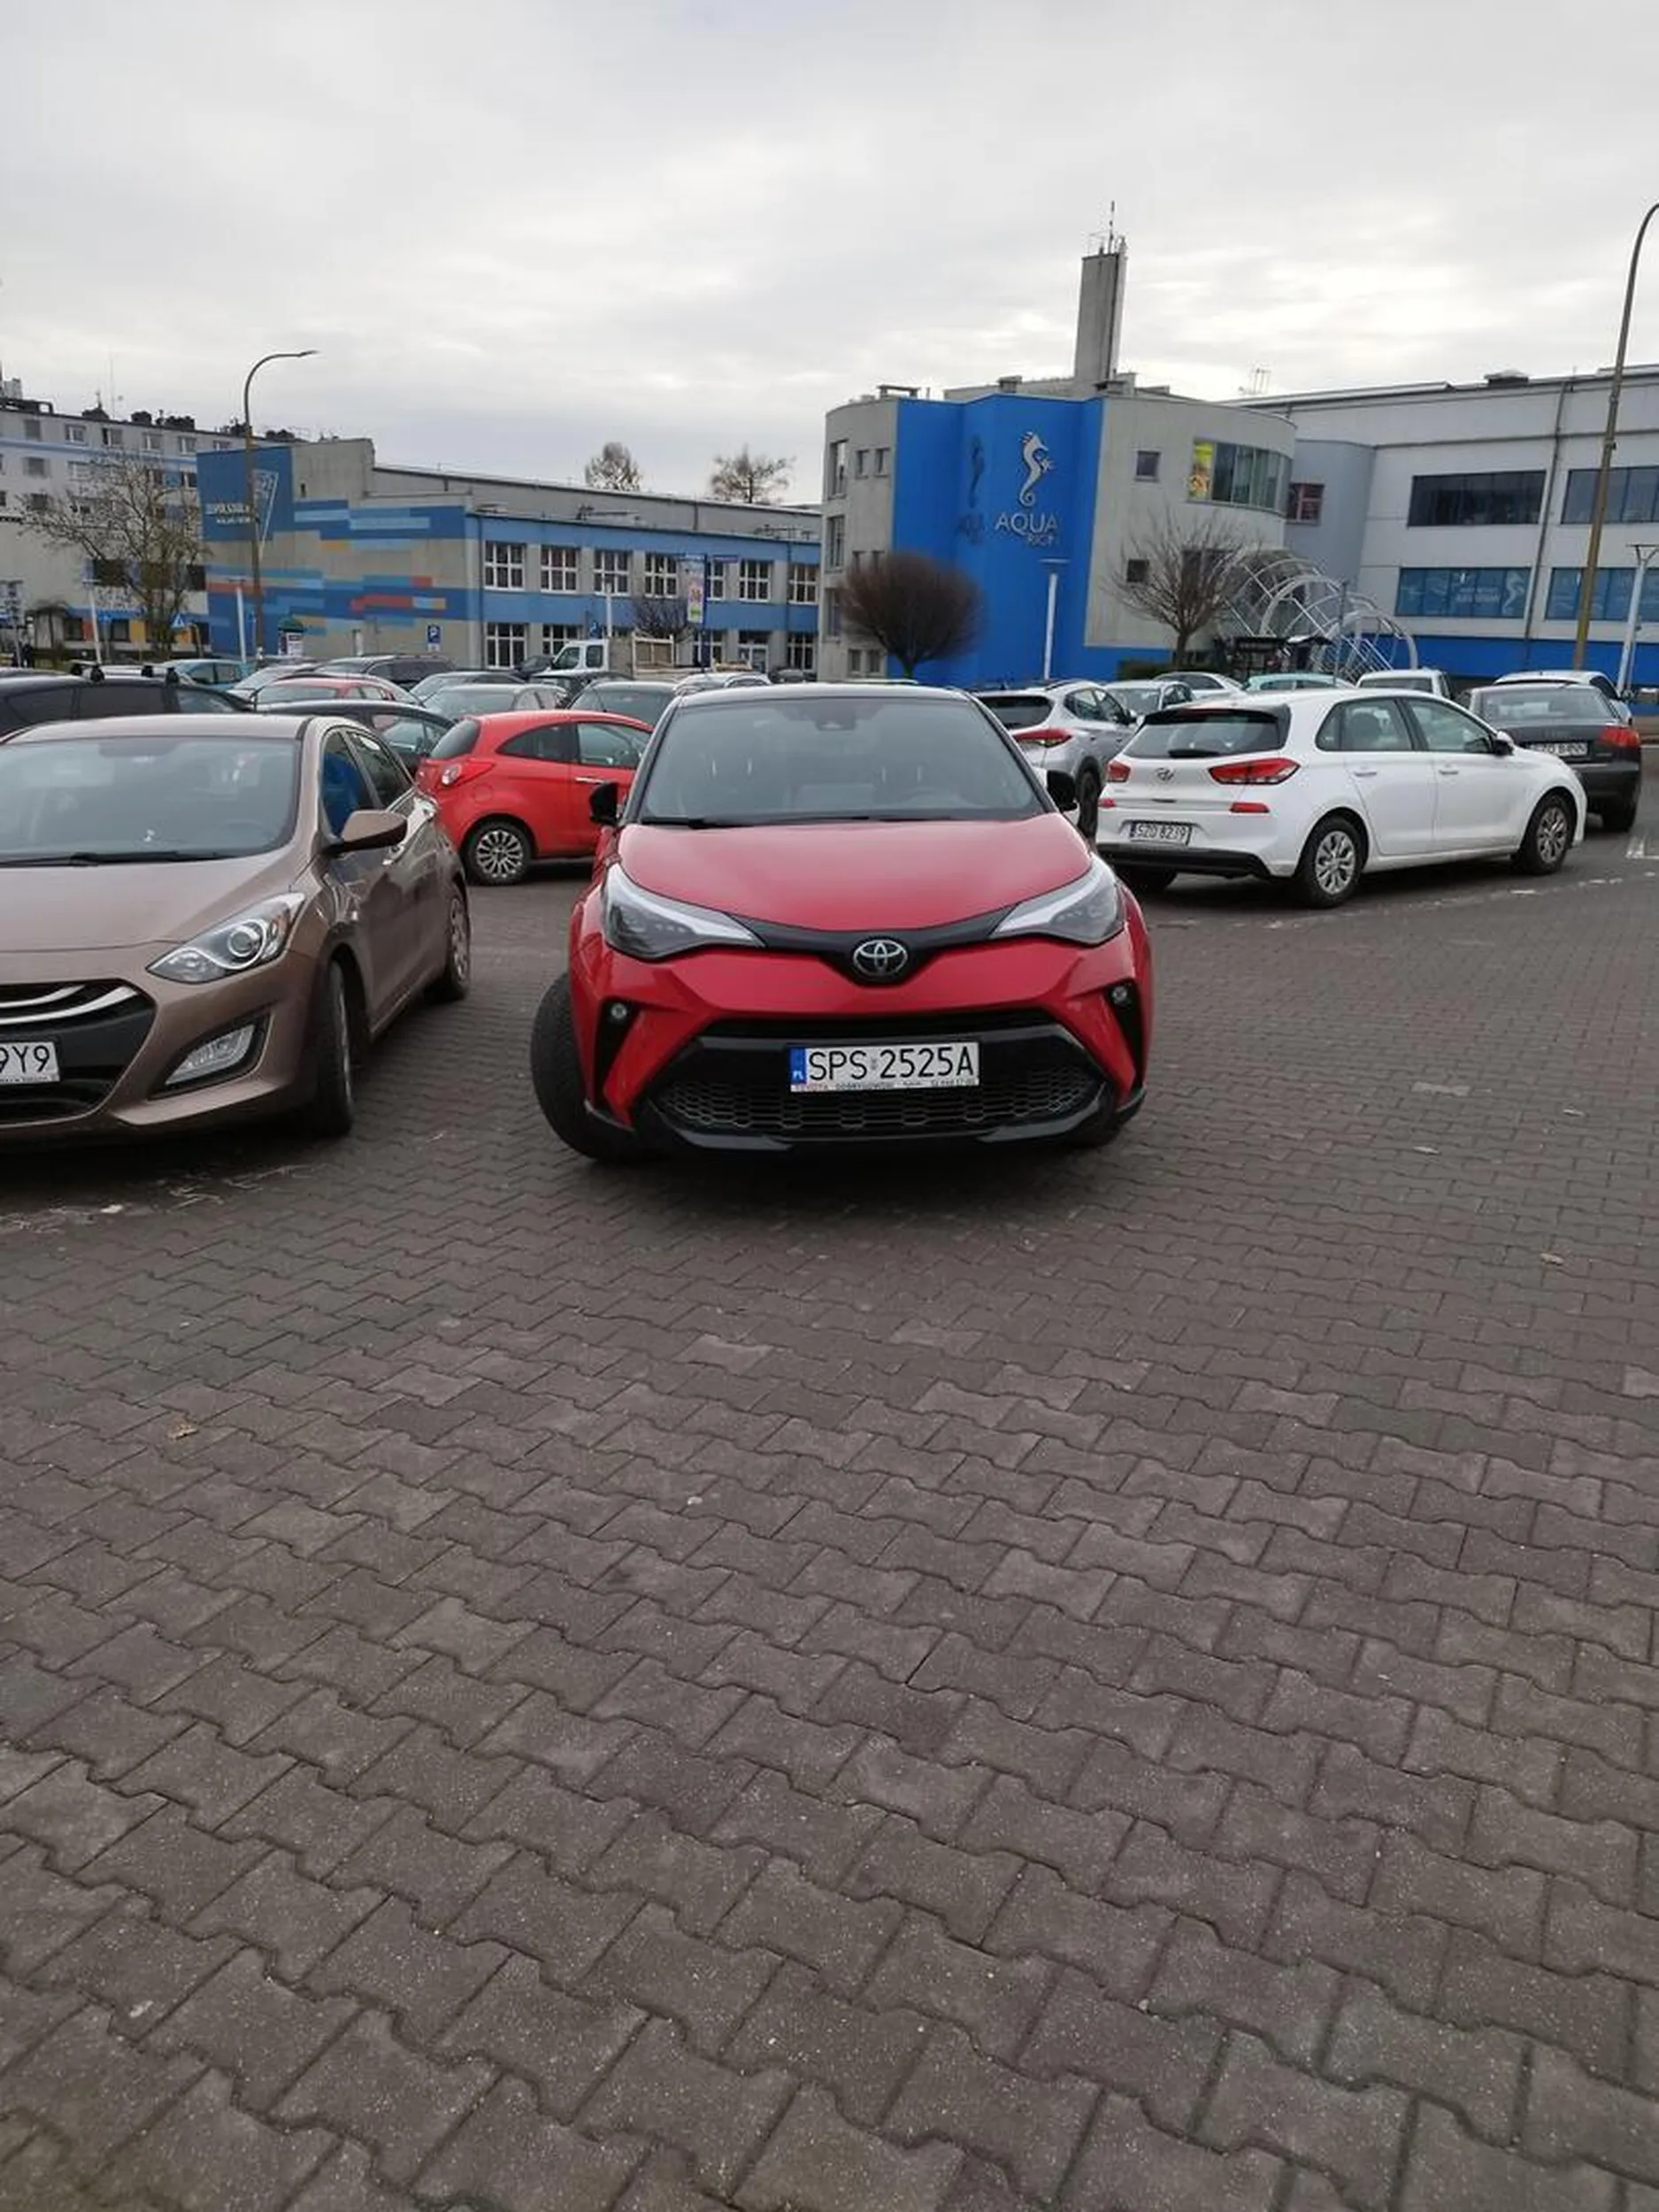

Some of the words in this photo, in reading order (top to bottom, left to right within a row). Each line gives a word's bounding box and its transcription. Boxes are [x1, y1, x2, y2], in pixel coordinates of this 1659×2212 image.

[995, 512, 1057, 535] AQUA
[809, 1050, 868, 1080] SPS
[880, 1046, 973, 1079] 2525A
